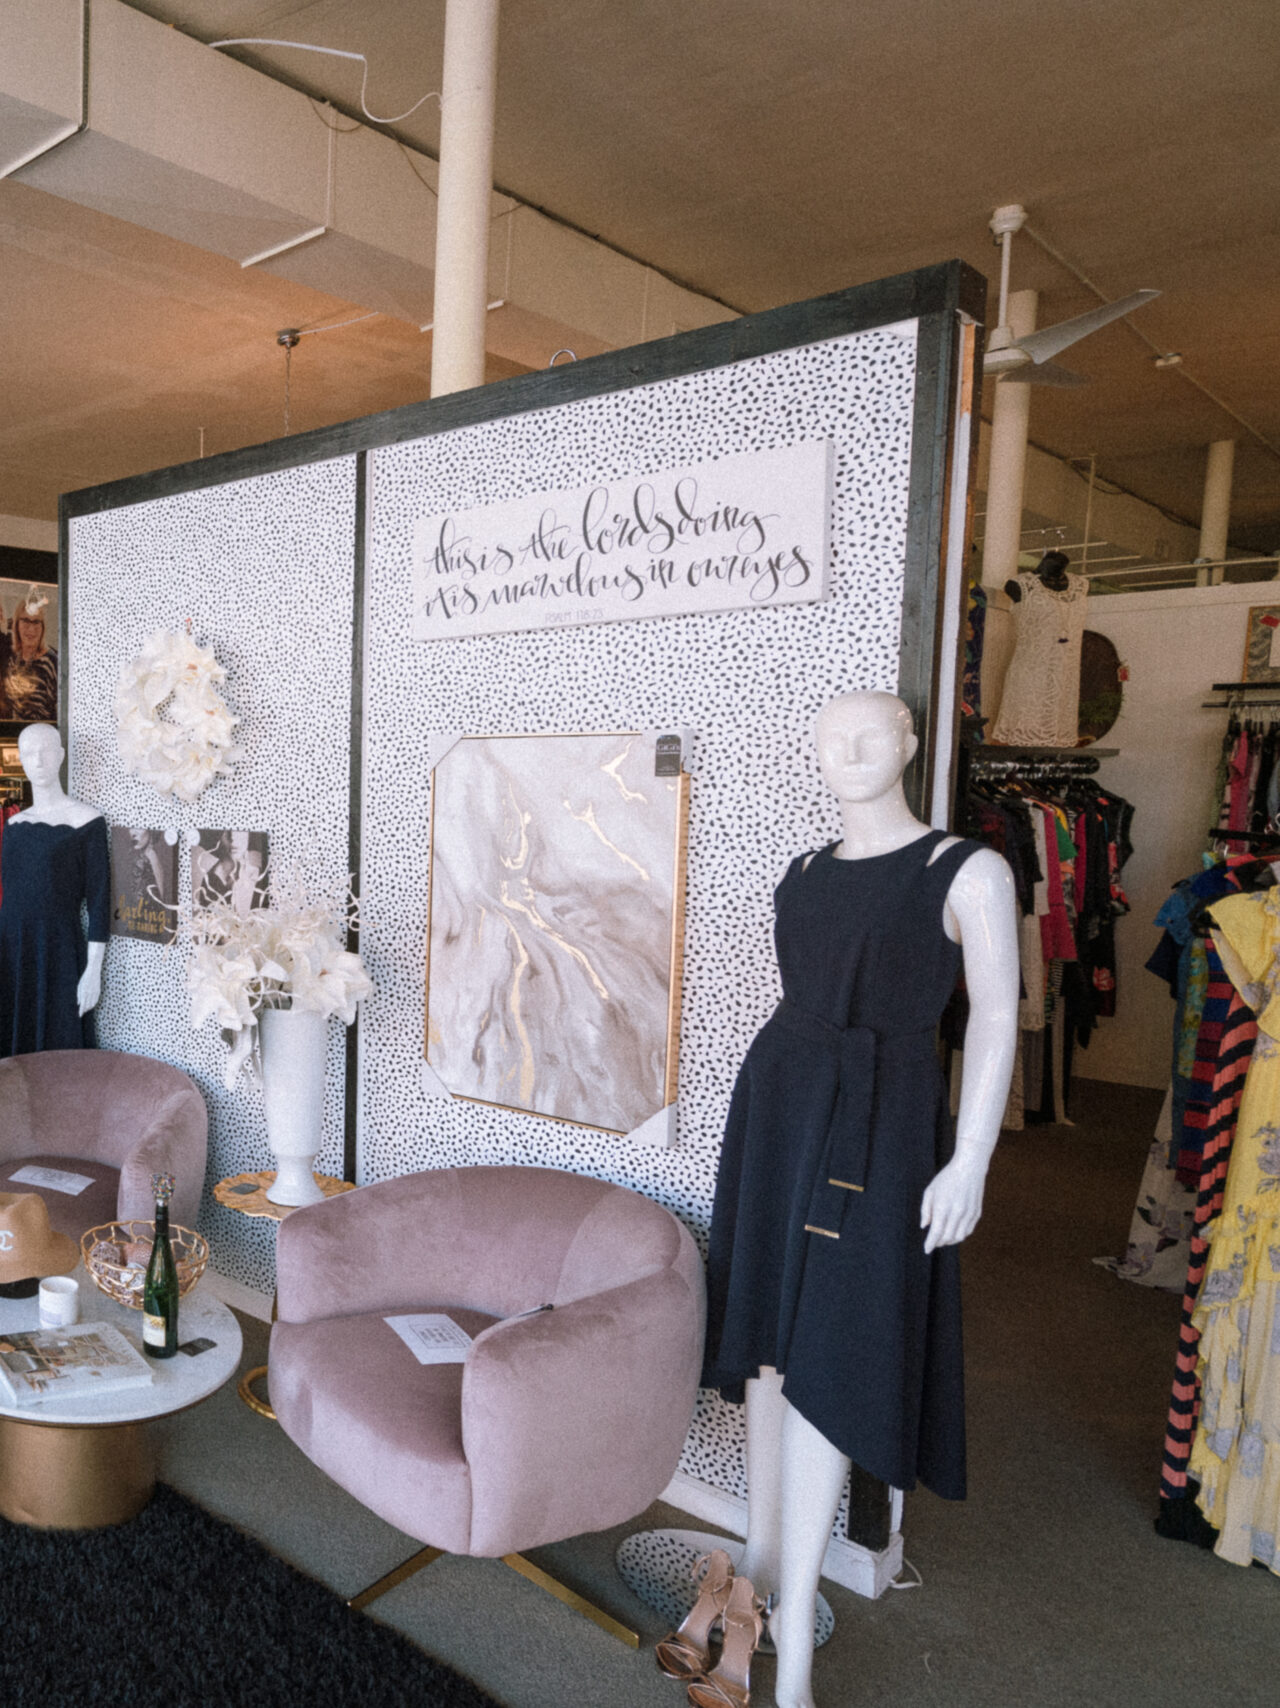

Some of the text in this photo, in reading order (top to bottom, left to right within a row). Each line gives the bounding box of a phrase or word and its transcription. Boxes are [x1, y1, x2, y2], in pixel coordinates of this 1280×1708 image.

[423, 518, 477, 580] this
[477, 544, 514, 576] is
[519, 507, 579, 566] the
[675, 476, 780, 555] doing
[648, 558, 680, 589] in
[687, 555, 738, 587] our
[741, 545, 813, 601] eyes
